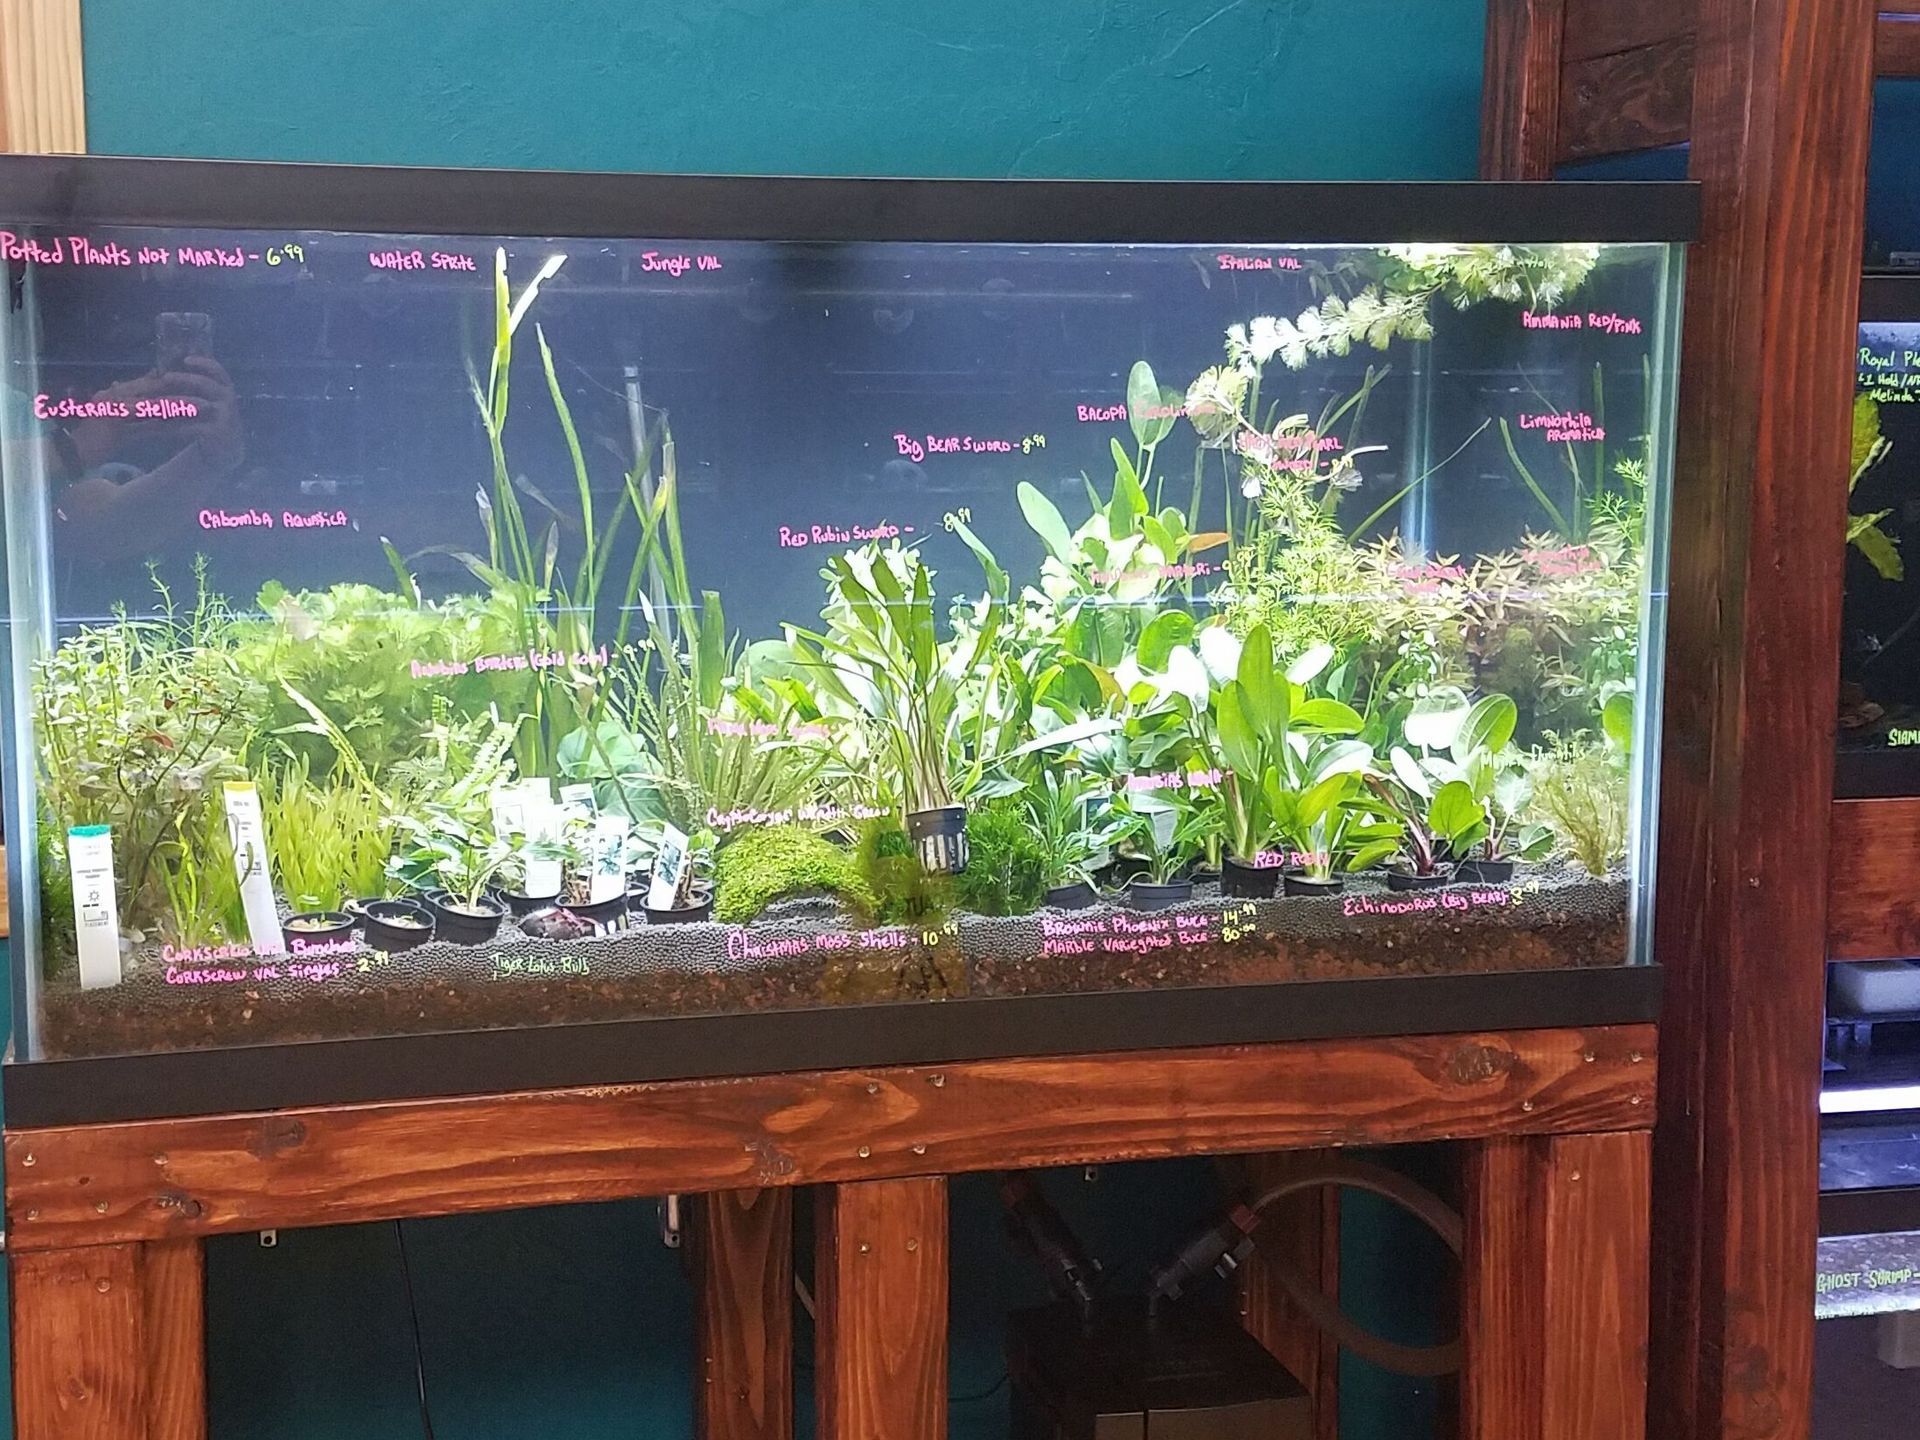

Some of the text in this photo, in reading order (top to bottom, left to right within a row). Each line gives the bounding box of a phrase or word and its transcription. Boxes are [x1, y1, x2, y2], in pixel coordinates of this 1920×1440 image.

[697, 255, 722, 271] VAL
[1859, 347, 1895, 371] Royal
[893, 433, 925, 462] Big
[1254, 849, 1284, 868] RED
